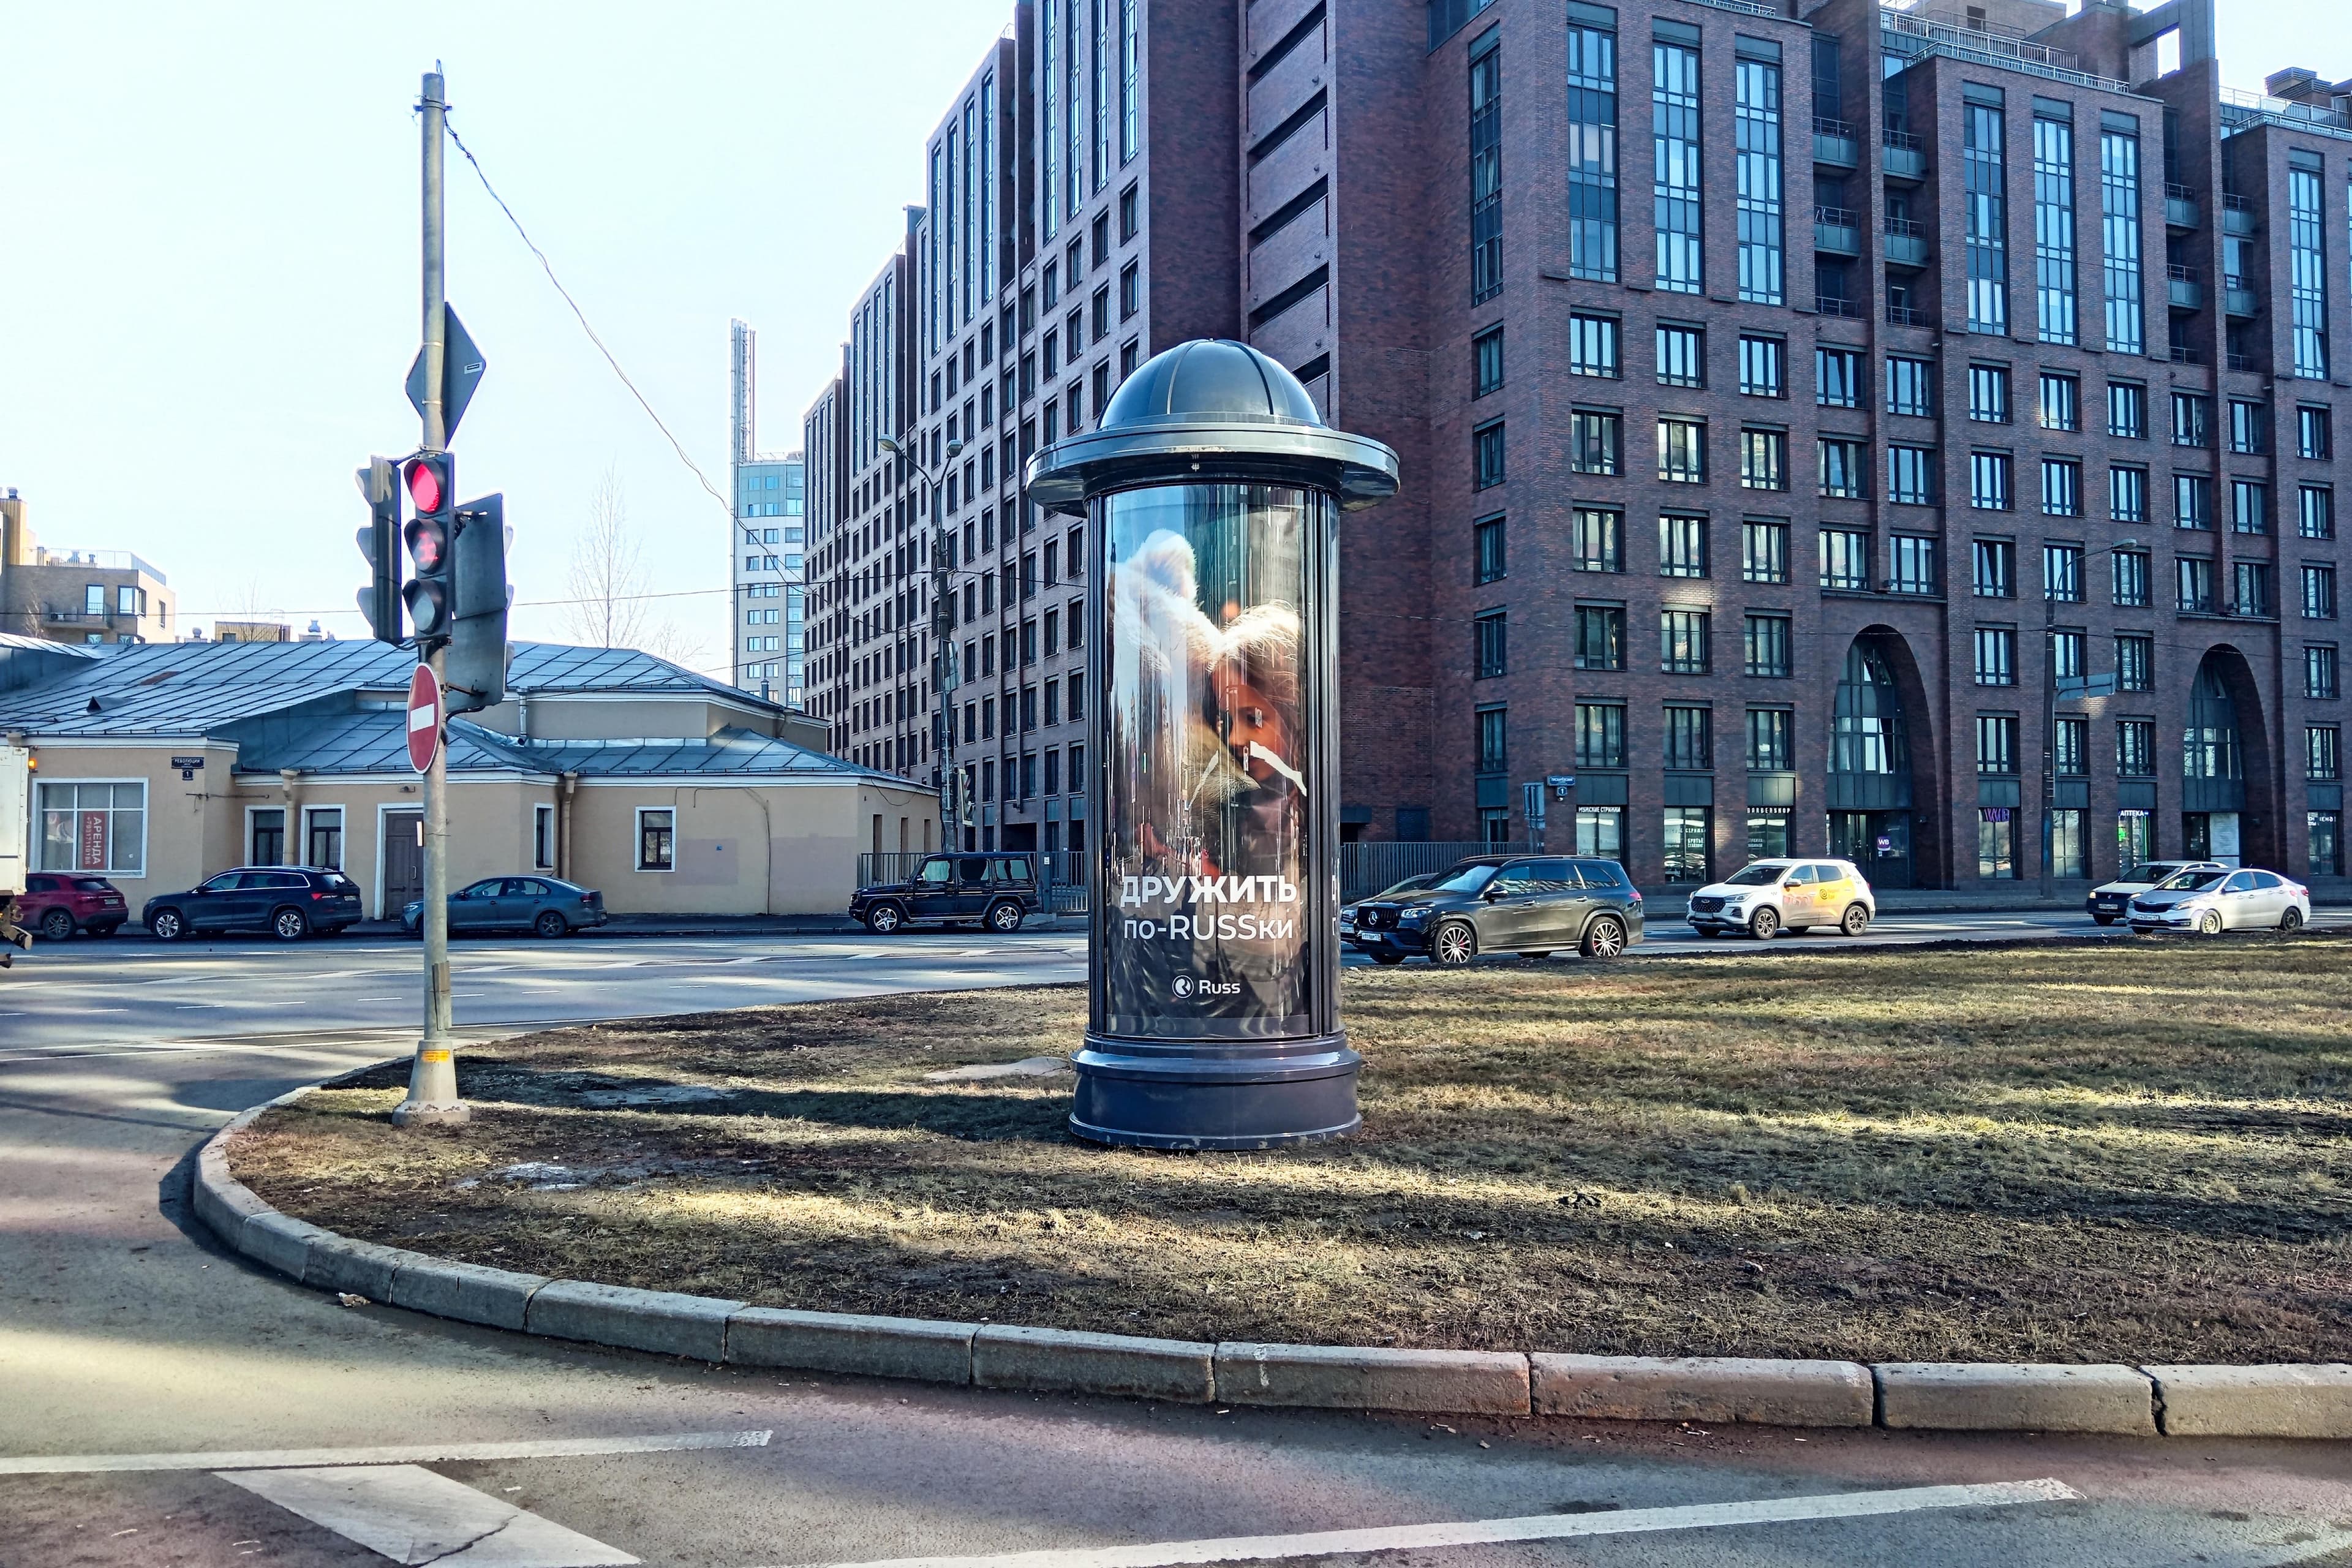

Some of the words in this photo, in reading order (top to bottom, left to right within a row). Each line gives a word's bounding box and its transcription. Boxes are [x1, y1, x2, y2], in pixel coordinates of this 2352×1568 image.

[92, 816, 102, 865] АРЕНДА
[1120, 875, 1297, 908] ДРУЖИТЬ
[1123, 913, 1293, 941] по-RUSSки
[1199, 979, 1241, 995] Russ
